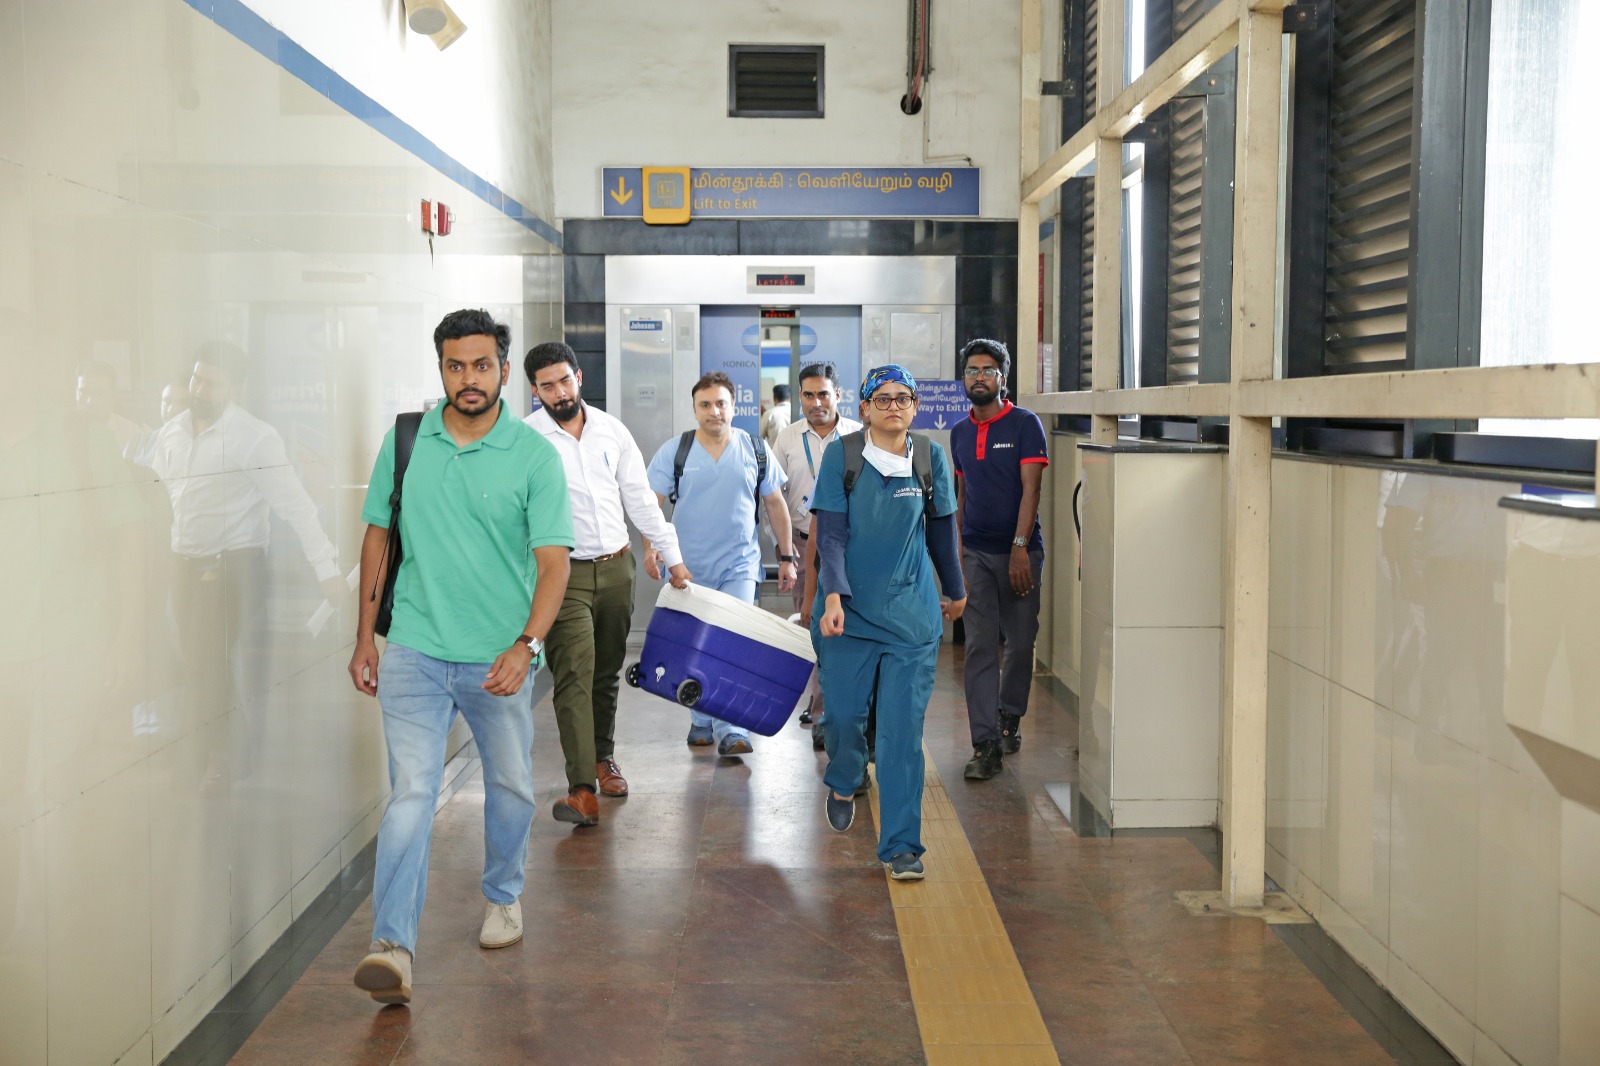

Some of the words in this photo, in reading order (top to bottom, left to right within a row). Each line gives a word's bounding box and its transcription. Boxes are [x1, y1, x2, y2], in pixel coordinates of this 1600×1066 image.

[694, 172, 784, 193] மின்தூக்கி
[797, 172, 913, 193] வெளியேறும்
[917, 173, 953, 193] வழி
[694, 198, 715, 210] Lift
[718, 199, 731, 210] to
[734, 198, 757, 210] Exit
[630, 321, 655, 330] Johnson
[723, 360, 756, 368] KONICA
[734, 406, 758, 416] ONIC
[918, 404, 934, 413] Way
